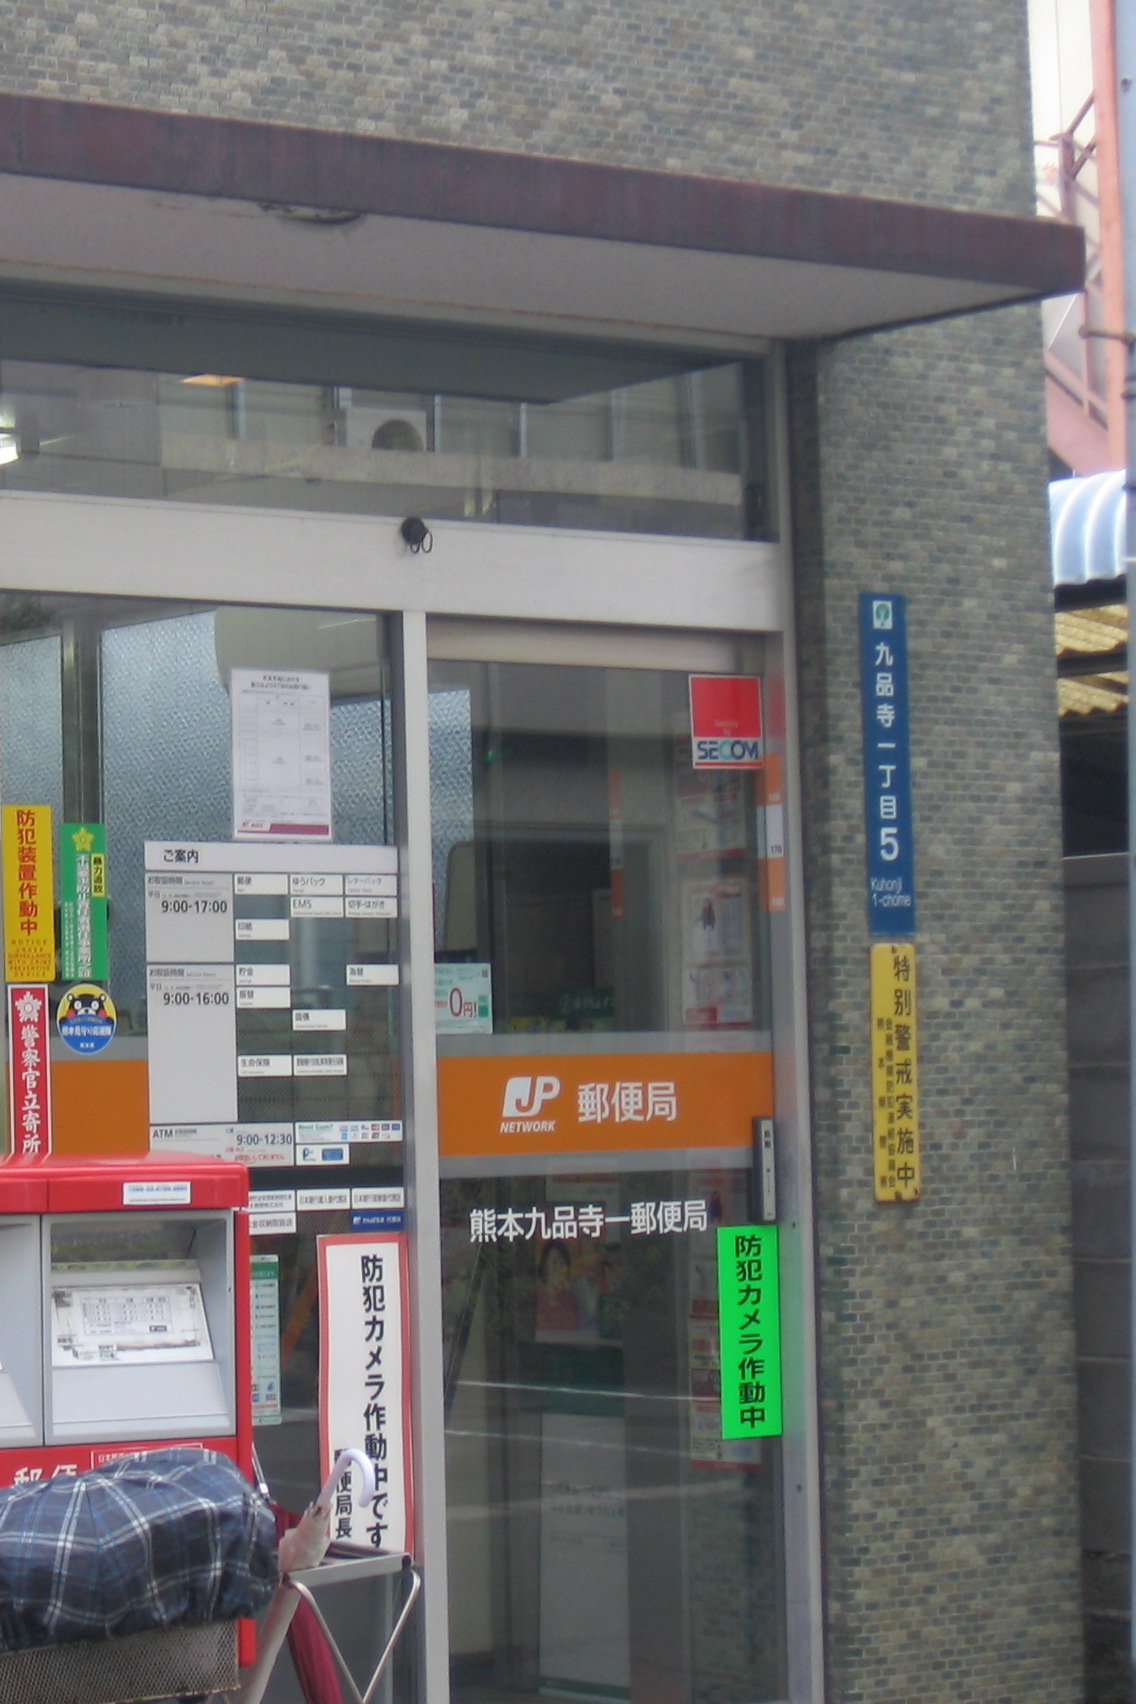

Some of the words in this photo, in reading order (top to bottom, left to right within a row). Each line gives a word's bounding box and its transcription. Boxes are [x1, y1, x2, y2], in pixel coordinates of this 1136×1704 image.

[696, 740, 759, 760] SECOM
[163, 849, 199, 864] ご案内
[16, 809, 39, 937] 防犯装置作動中
[292, 877, 326, 887] ゆうパック
[871, 878, 902, 894] Kuhonji
[161, 900, 228, 914] 9:00-17:00
[293, 900, 312, 909] EMS
[872, 893, 912, 907] 1-chome
[163, 992, 229, 1006] 9:00-16:00
[893, 955, 915, 1188] 特別警戒実施中
[21, 1022, 41, 1155] 警察官立寄所
[502, 1076, 561, 1117] JP
[577, 1081, 678, 1122] 郵便局
[152, 1129, 173, 1139] ATM
[500, 1120, 556, 1133] NETWORK
[236, 1134, 293, 1146] 9:00-12:30
[469, 1200, 708, 1243] 熊本九品寺一郵便局
[734, 1235, 766, 1429] 防犯カメラ作動中
